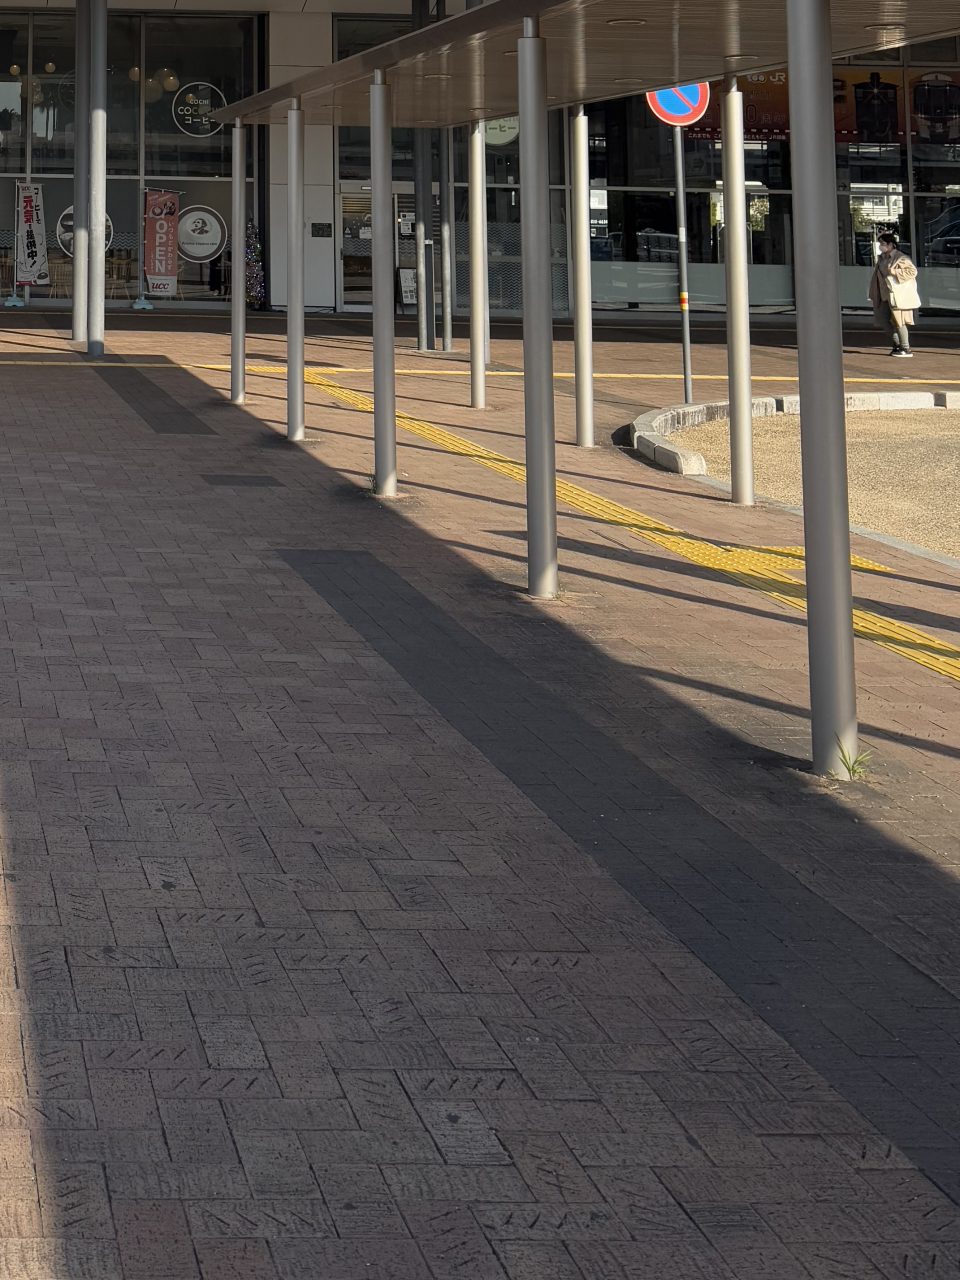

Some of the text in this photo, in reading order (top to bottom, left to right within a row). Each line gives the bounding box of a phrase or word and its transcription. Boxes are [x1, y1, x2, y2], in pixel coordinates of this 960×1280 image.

[770, 73, 786, 82] JR
[485, 124, 517, 133] ーヒー
[155, 220, 168, 273] OPEN
